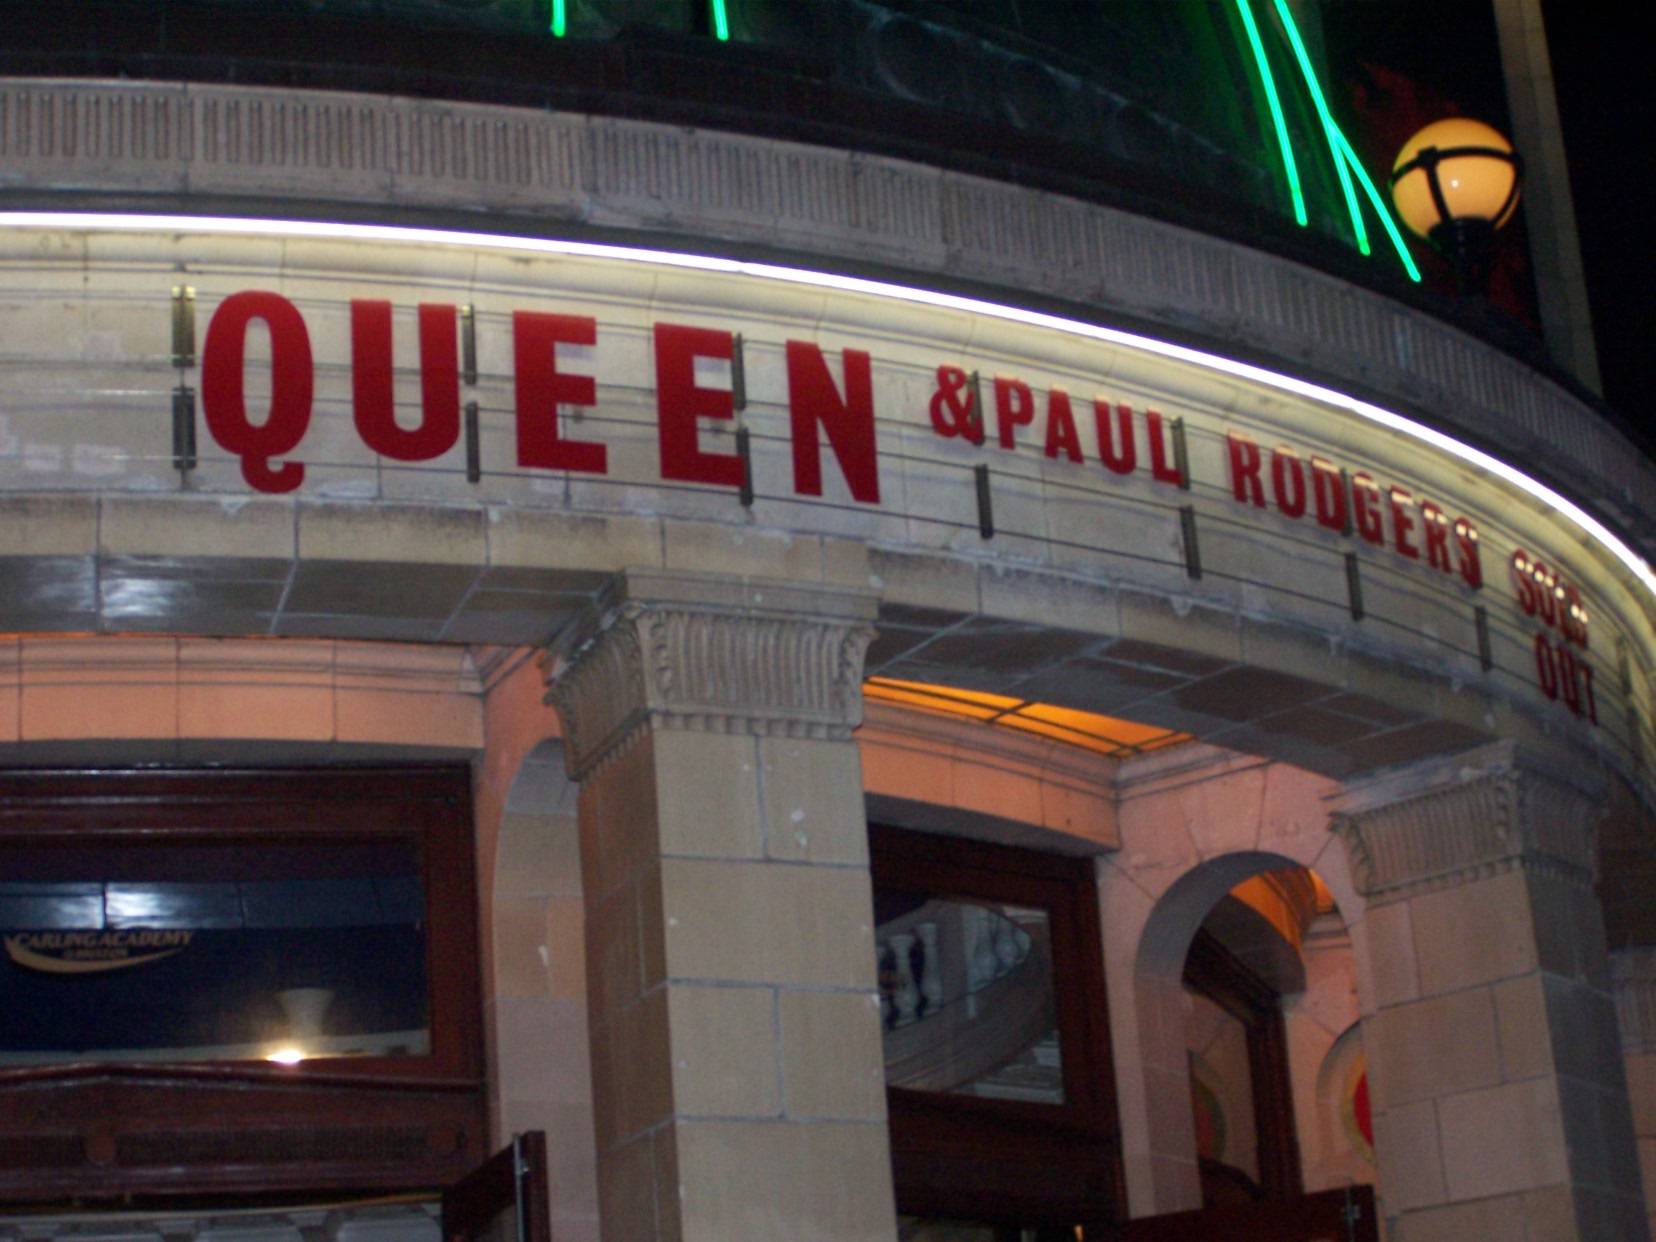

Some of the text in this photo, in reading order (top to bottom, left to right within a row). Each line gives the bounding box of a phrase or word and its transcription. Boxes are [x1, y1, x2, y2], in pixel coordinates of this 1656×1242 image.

[202, 290, 880, 504] QUEEN
[930, 365, 984, 445] &
[994, 373, 1184, 486] PAUL
[1227, 430, 1482, 589] RODGERS
[100, 930, 192, 947] ACADEMY
